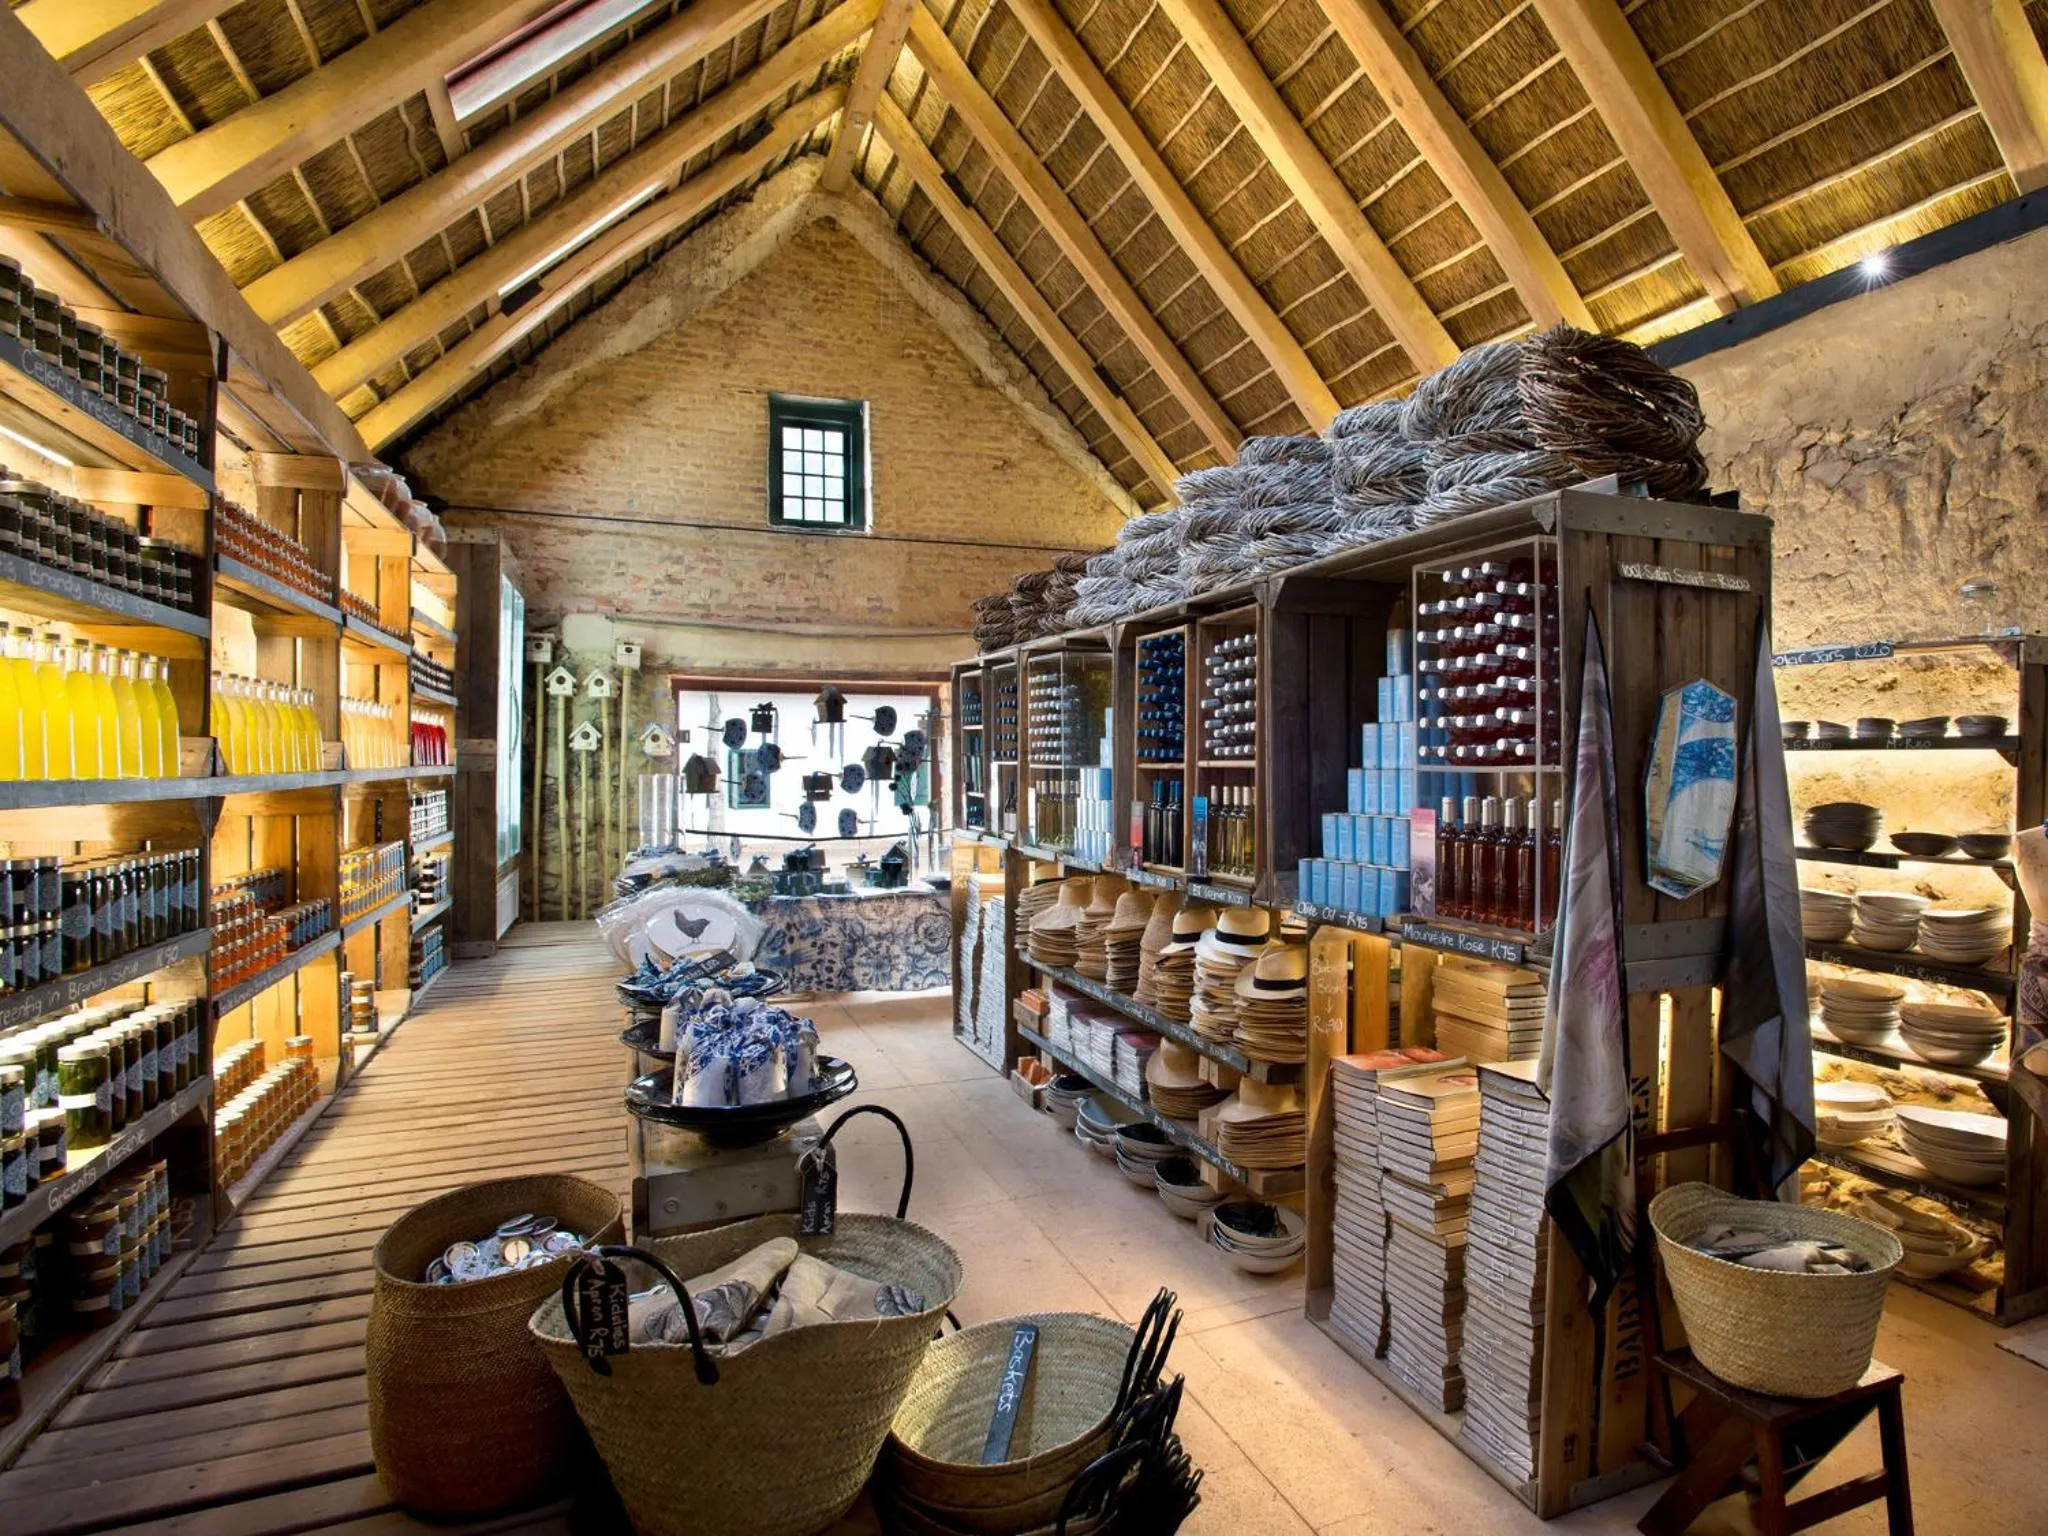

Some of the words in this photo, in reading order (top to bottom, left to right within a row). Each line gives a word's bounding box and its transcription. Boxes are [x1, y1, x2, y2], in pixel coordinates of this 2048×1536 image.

[28, 562, 81, 600] Brandy
[1813, 651, 1845, 664] Jars
[1321, 906, 1336, 921] Oil
[0, 992, 43, 1026] reenfig
[997, 1329, 1036, 1413] Baskets
